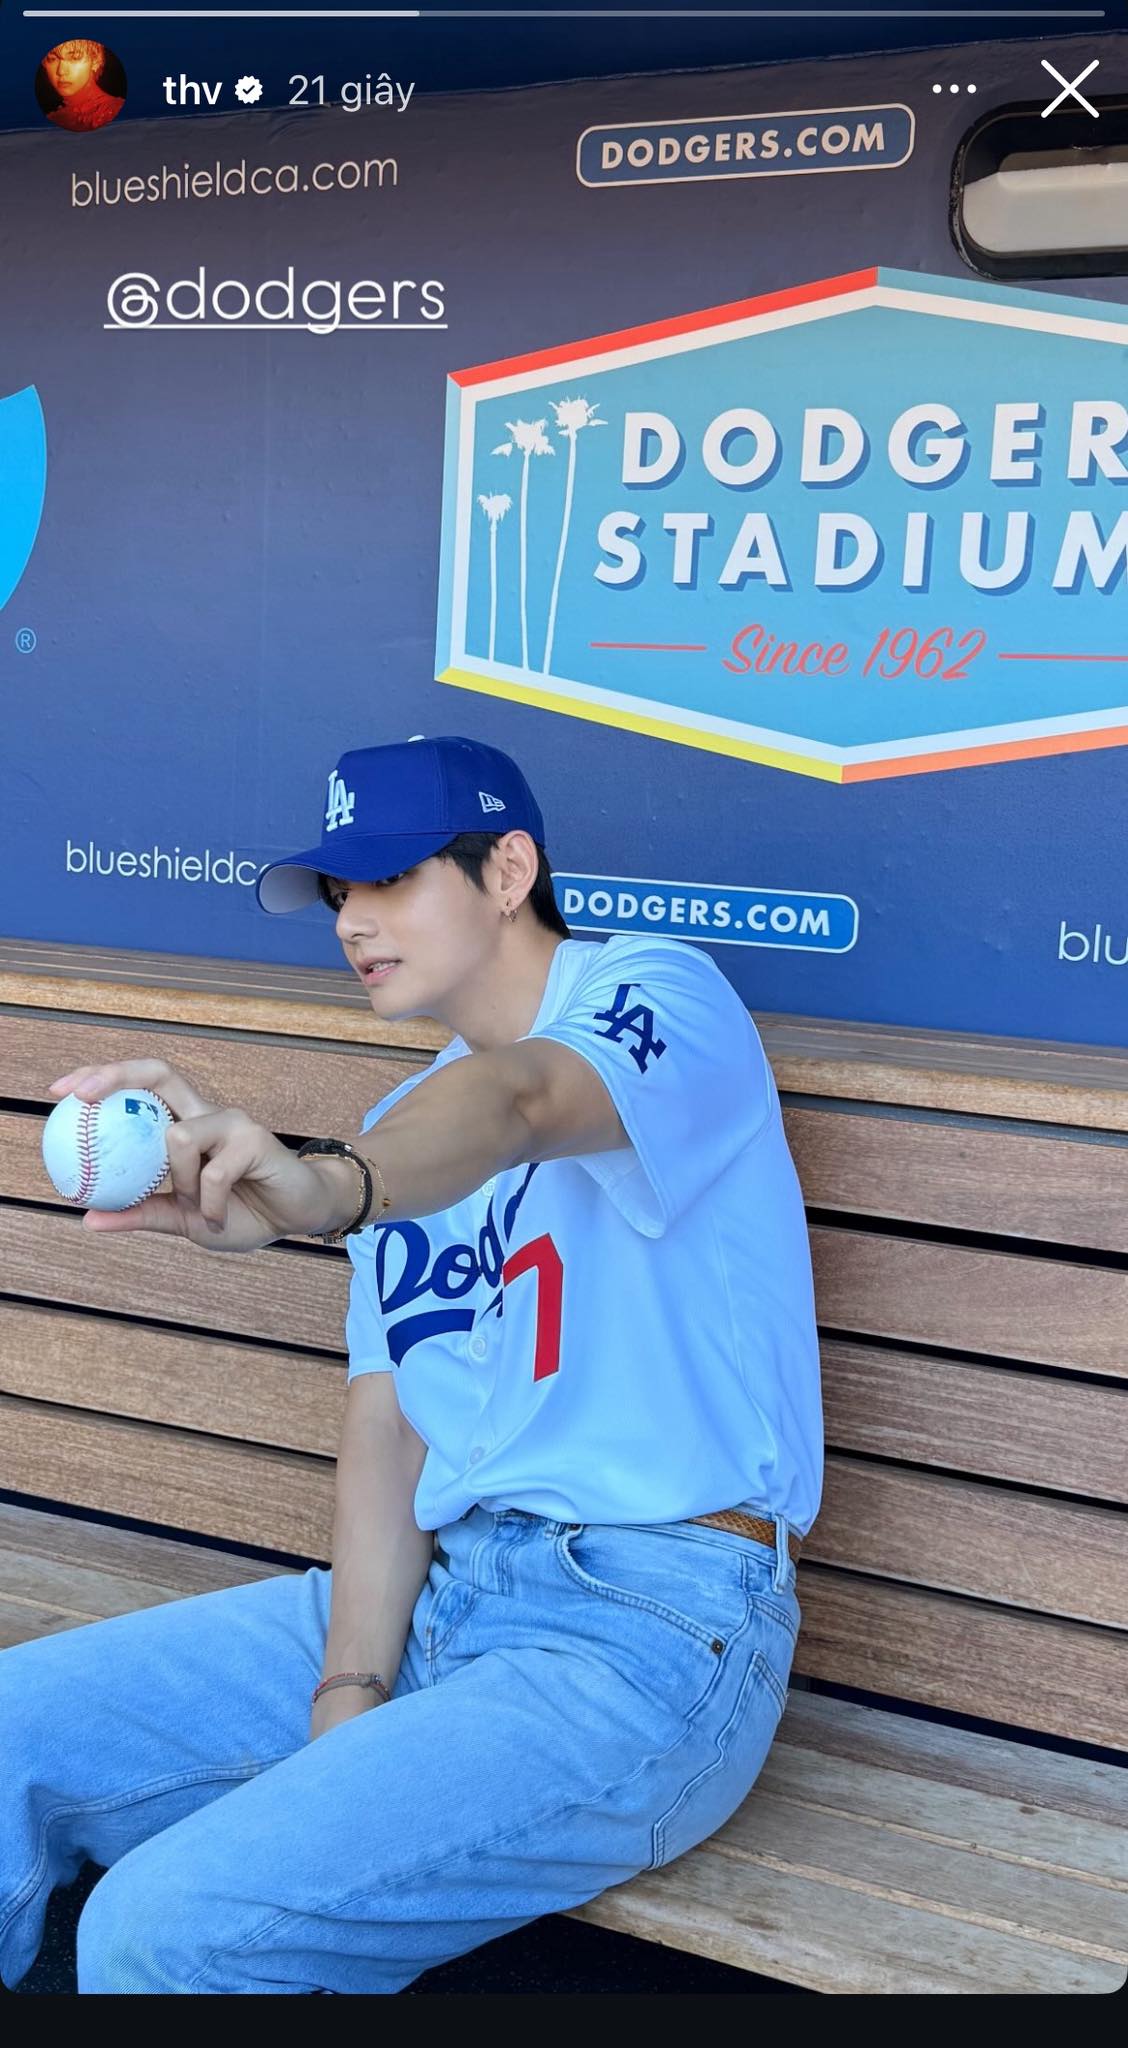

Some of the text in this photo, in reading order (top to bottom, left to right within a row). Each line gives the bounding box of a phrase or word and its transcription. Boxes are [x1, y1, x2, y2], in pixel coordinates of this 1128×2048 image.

[601, 122, 886, 170] DODGERS.COM
[71, 157, 399, 207] blueshieldca.com
[594, 510, 1128, 595] STADIUM
[722, 624, 988, 681] Since 1962
[325, 770, 355, 832] LA
[66, 840, 271, 886] blueshieldc
[564, 888, 831, 938] DODGERS.COM
[502, 1232, 564, 1383] 7
